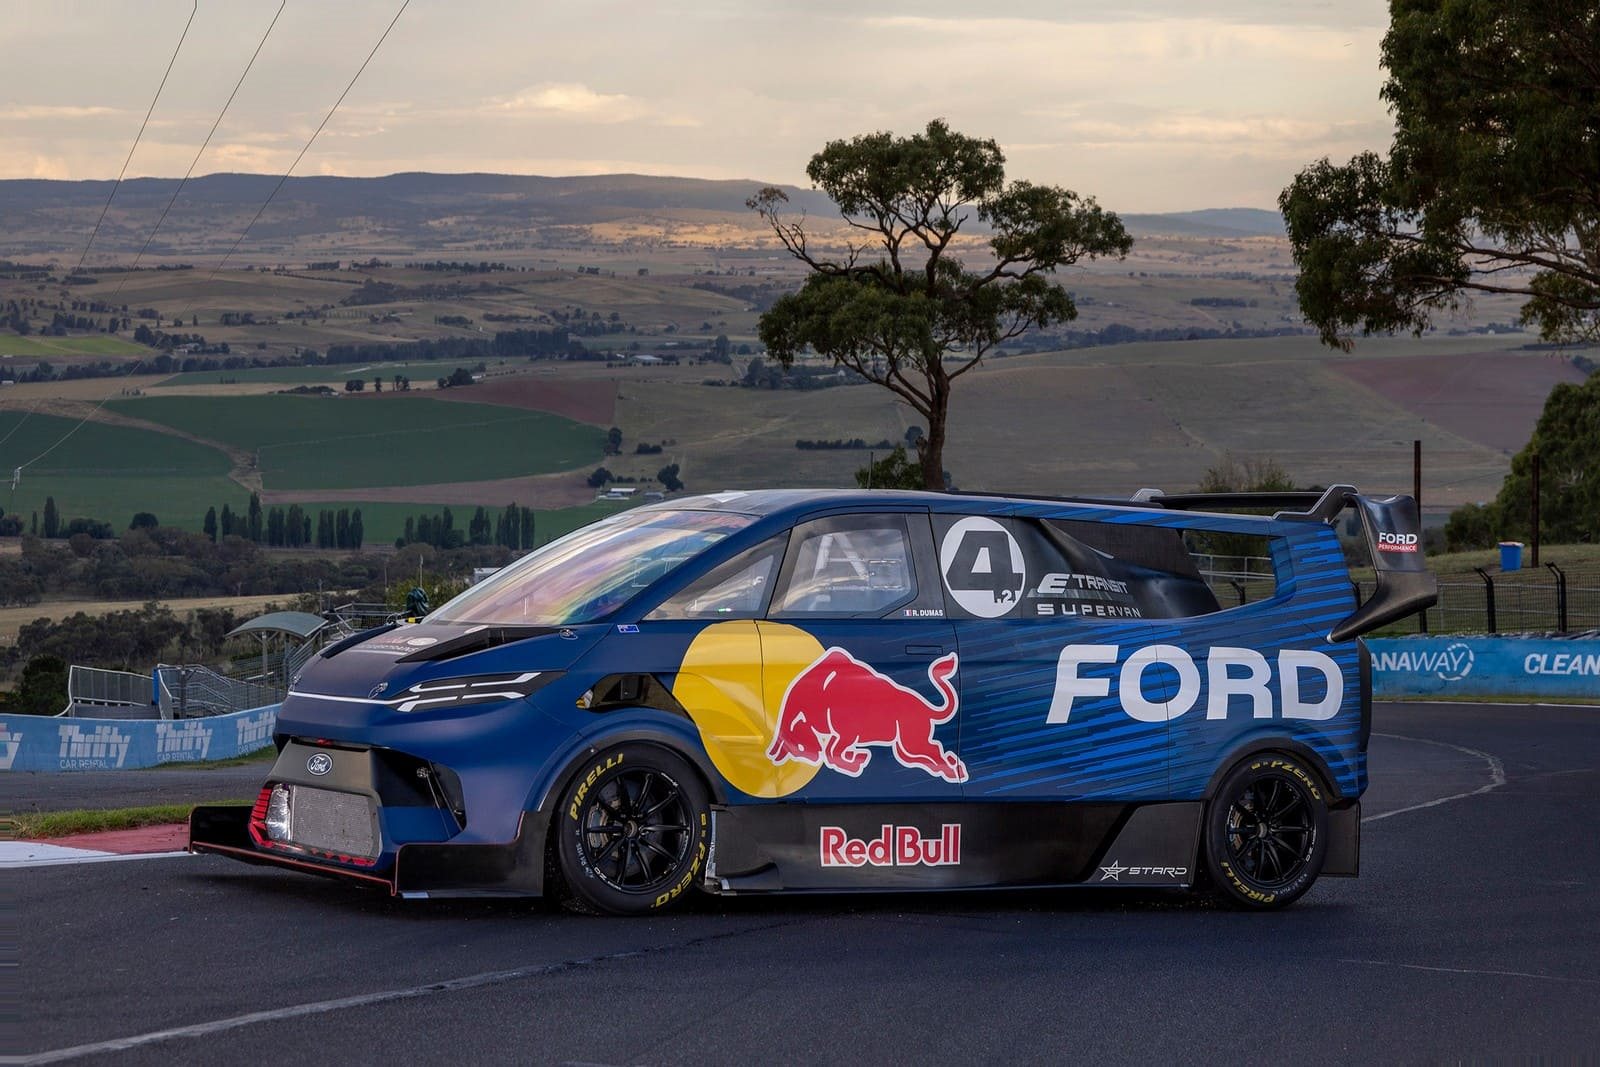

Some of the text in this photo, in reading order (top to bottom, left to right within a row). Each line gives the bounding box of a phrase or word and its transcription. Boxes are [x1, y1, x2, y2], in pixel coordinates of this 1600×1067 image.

[1379, 532, 1418, 545] FORD
[1072, 574, 1128, 595] TRANSIT
[912, 609, 943, 617] R. DUMAS
[1036, 603, 1141, 618] SUPERVAN
[1046, 644, 1344, 724] FORD
[58, 724, 131, 768] Thrifty
[156, 721, 213, 759] Thrifty
[60, 759, 108, 769] CAR RENTAL
[157, 753, 171, 762] CAR
[569, 753, 624, 821] PIRELLI
[820, 823, 962, 867] Red Bull
[1128, 867, 1188, 878] STARD
[1220, 861, 1276, 903] PIRELLI
